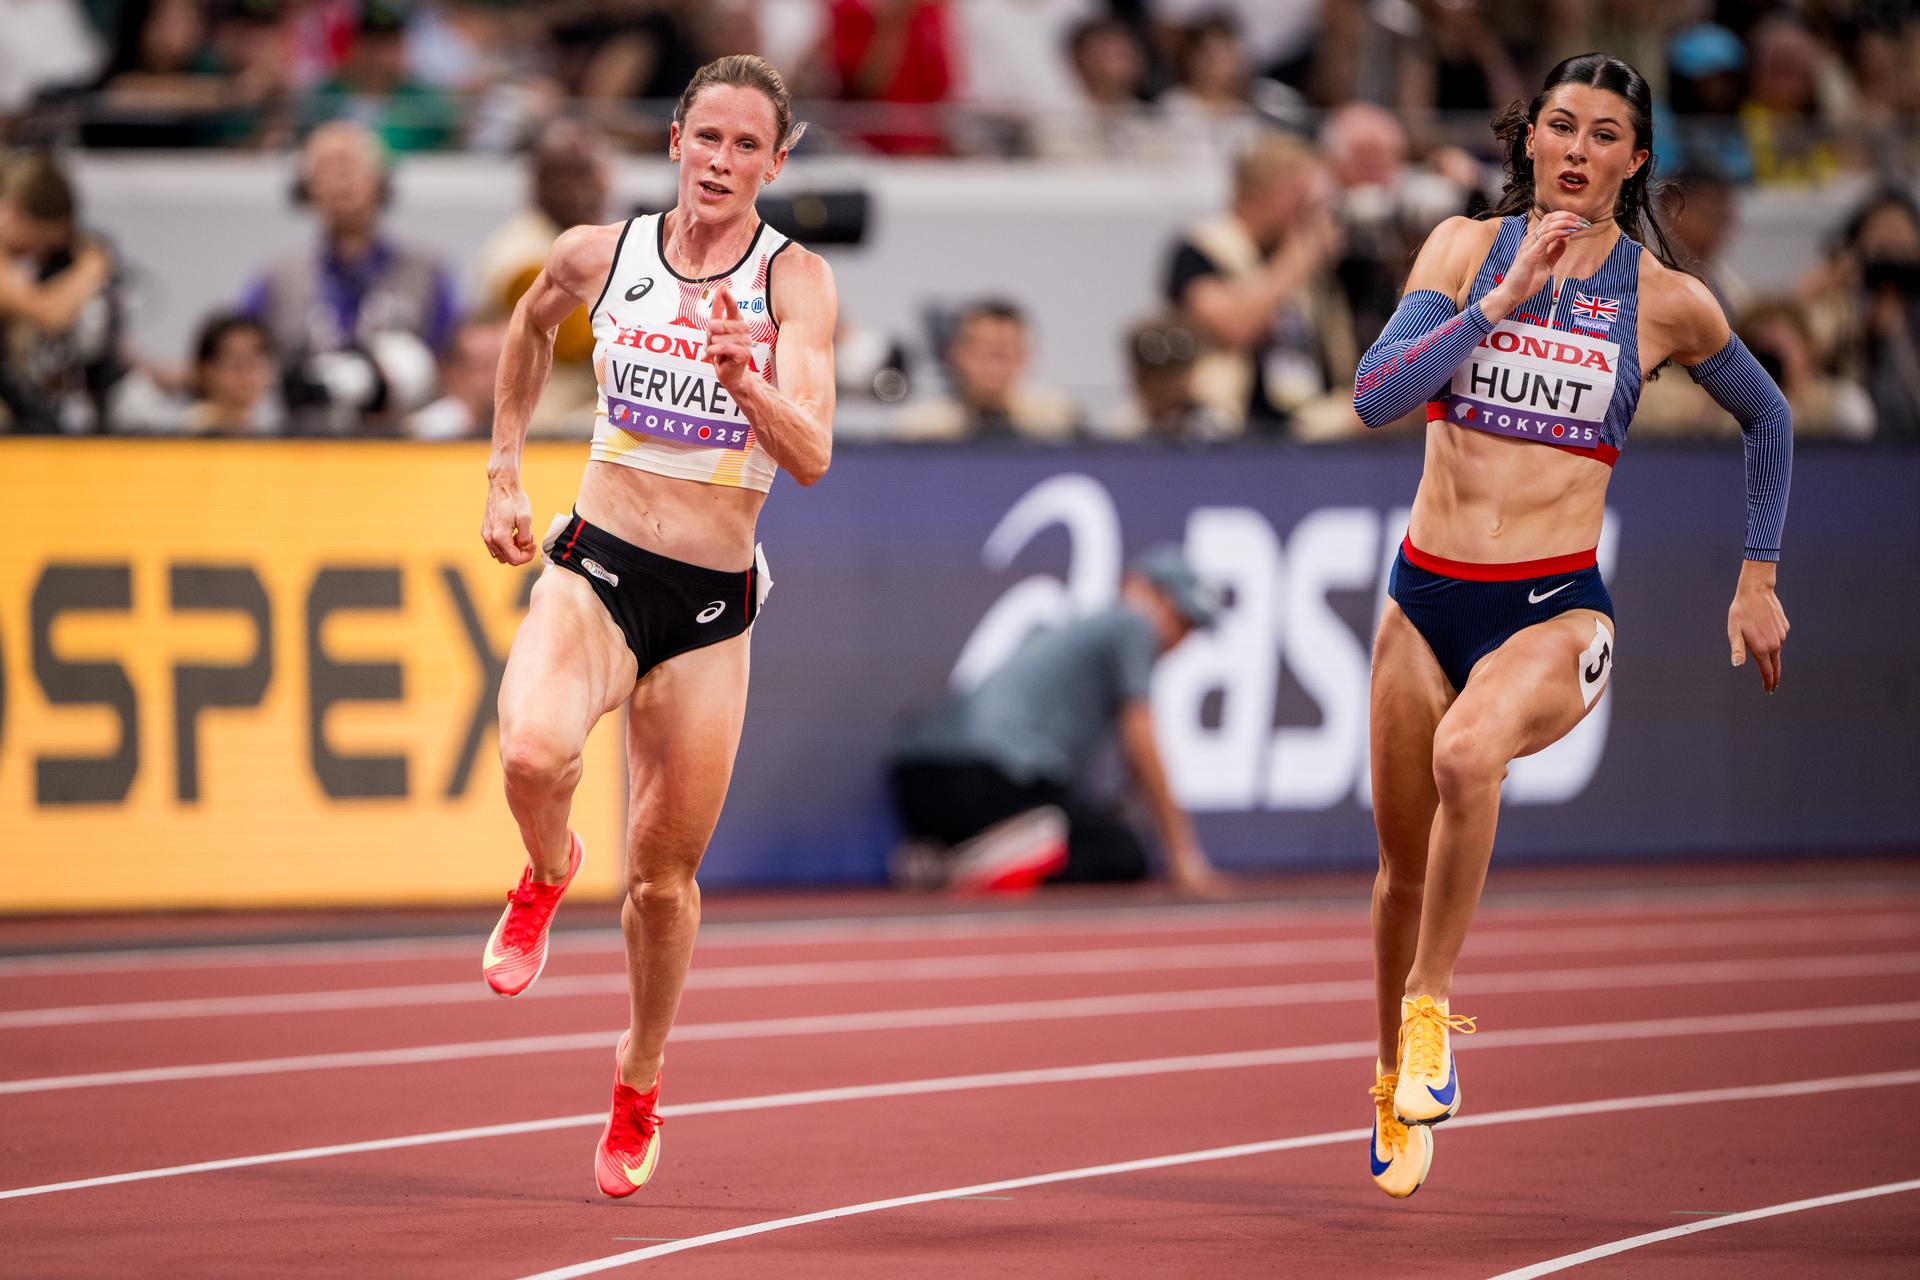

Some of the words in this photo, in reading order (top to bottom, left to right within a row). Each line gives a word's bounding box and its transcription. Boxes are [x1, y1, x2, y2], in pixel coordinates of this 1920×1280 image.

[613, 327, 760, 373] HON
[1471, 362, 1593, 414] HUNT
[0, 562, 540, 806] SPEX
[1585, 641, 1610, 684] 5
